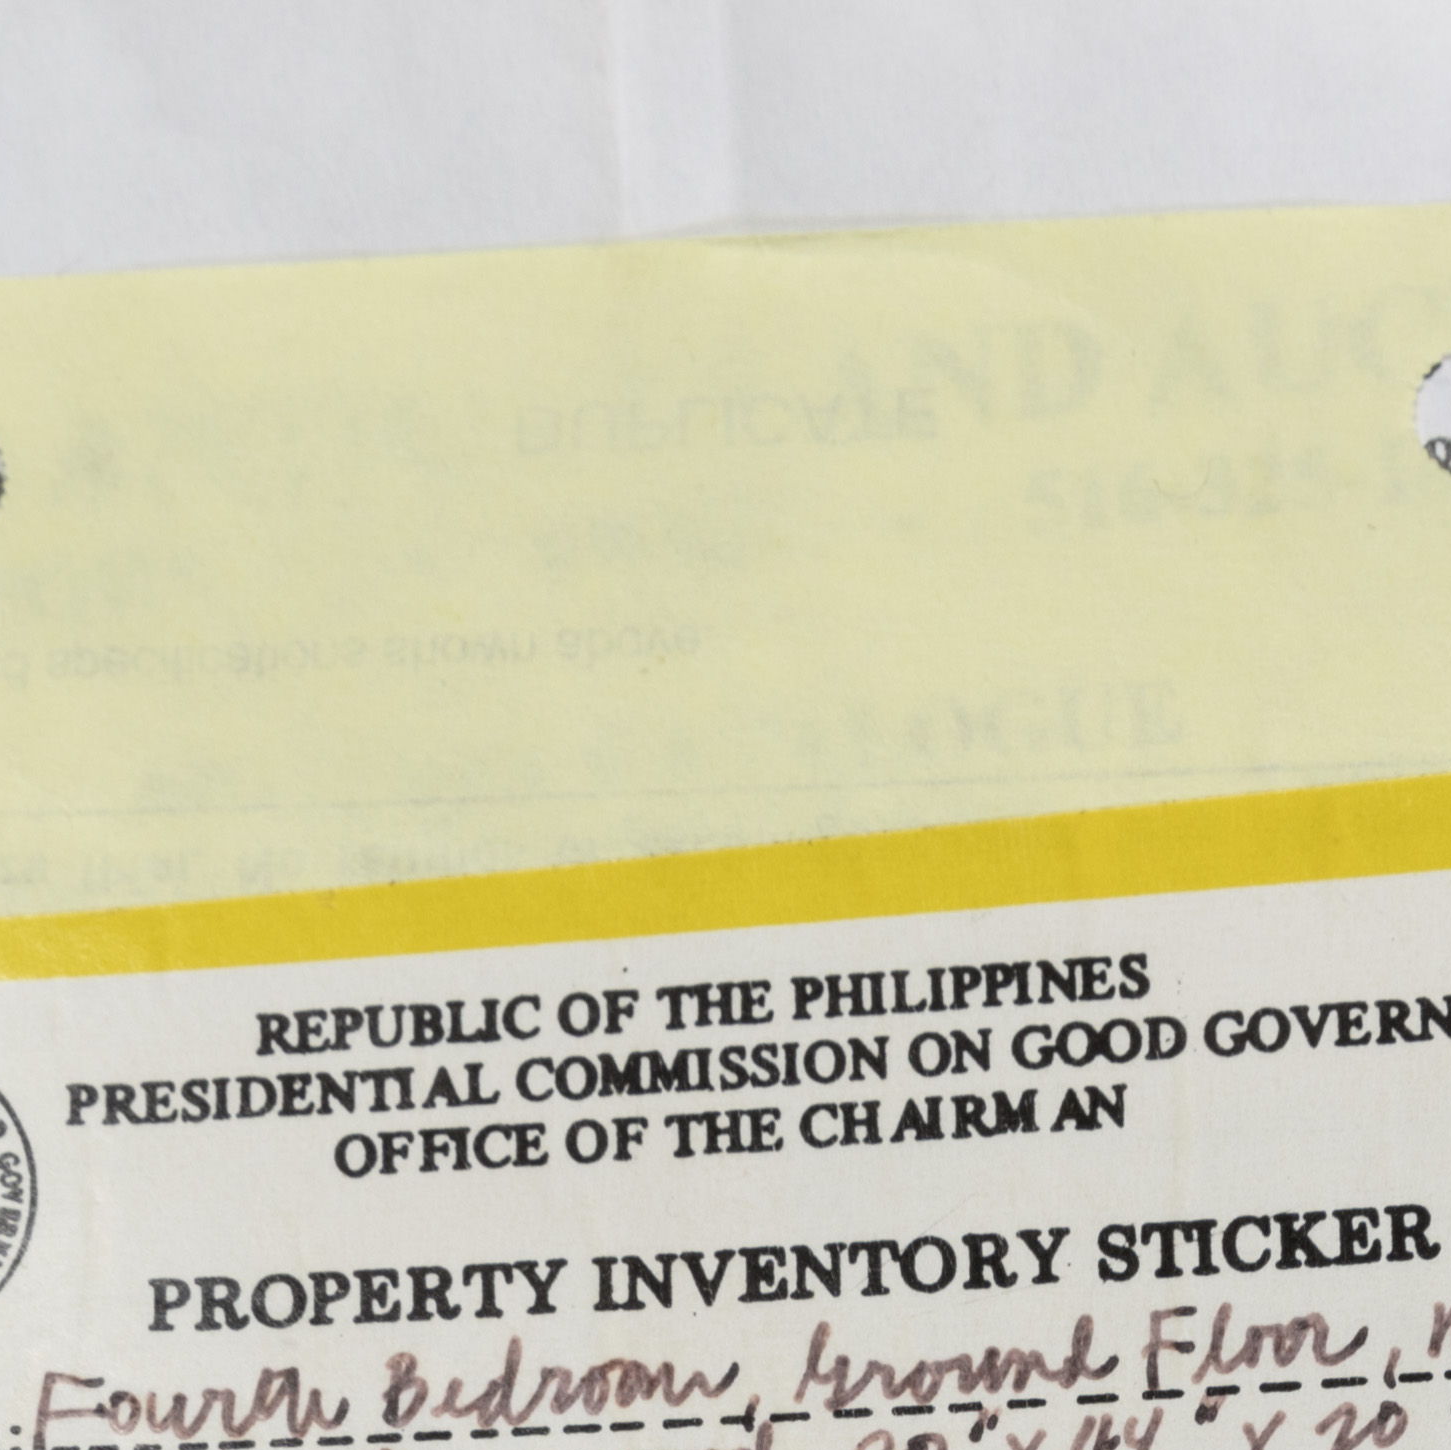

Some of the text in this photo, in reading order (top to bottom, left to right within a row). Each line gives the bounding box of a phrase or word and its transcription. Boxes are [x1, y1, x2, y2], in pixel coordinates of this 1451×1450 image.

[257, 953, 1150, 1056] REPUBLIC OF THE PHILIPPINES
[67, 1063, 500, 1125] PRESIDENTIAL
[516, 1036, 889, 1102] COMMISSION
[908, 1028, 992, 1077] ON
[1012, 1016, 1187, 1070] GOOD
[335, 1084, 1127, 1178] OFFICE OF THE CHAIRMAN
[149, 1204, 1441, 1331] PROPERTY INVENTORY STICKER
[795, 1315, 1119, 1411] Ground
